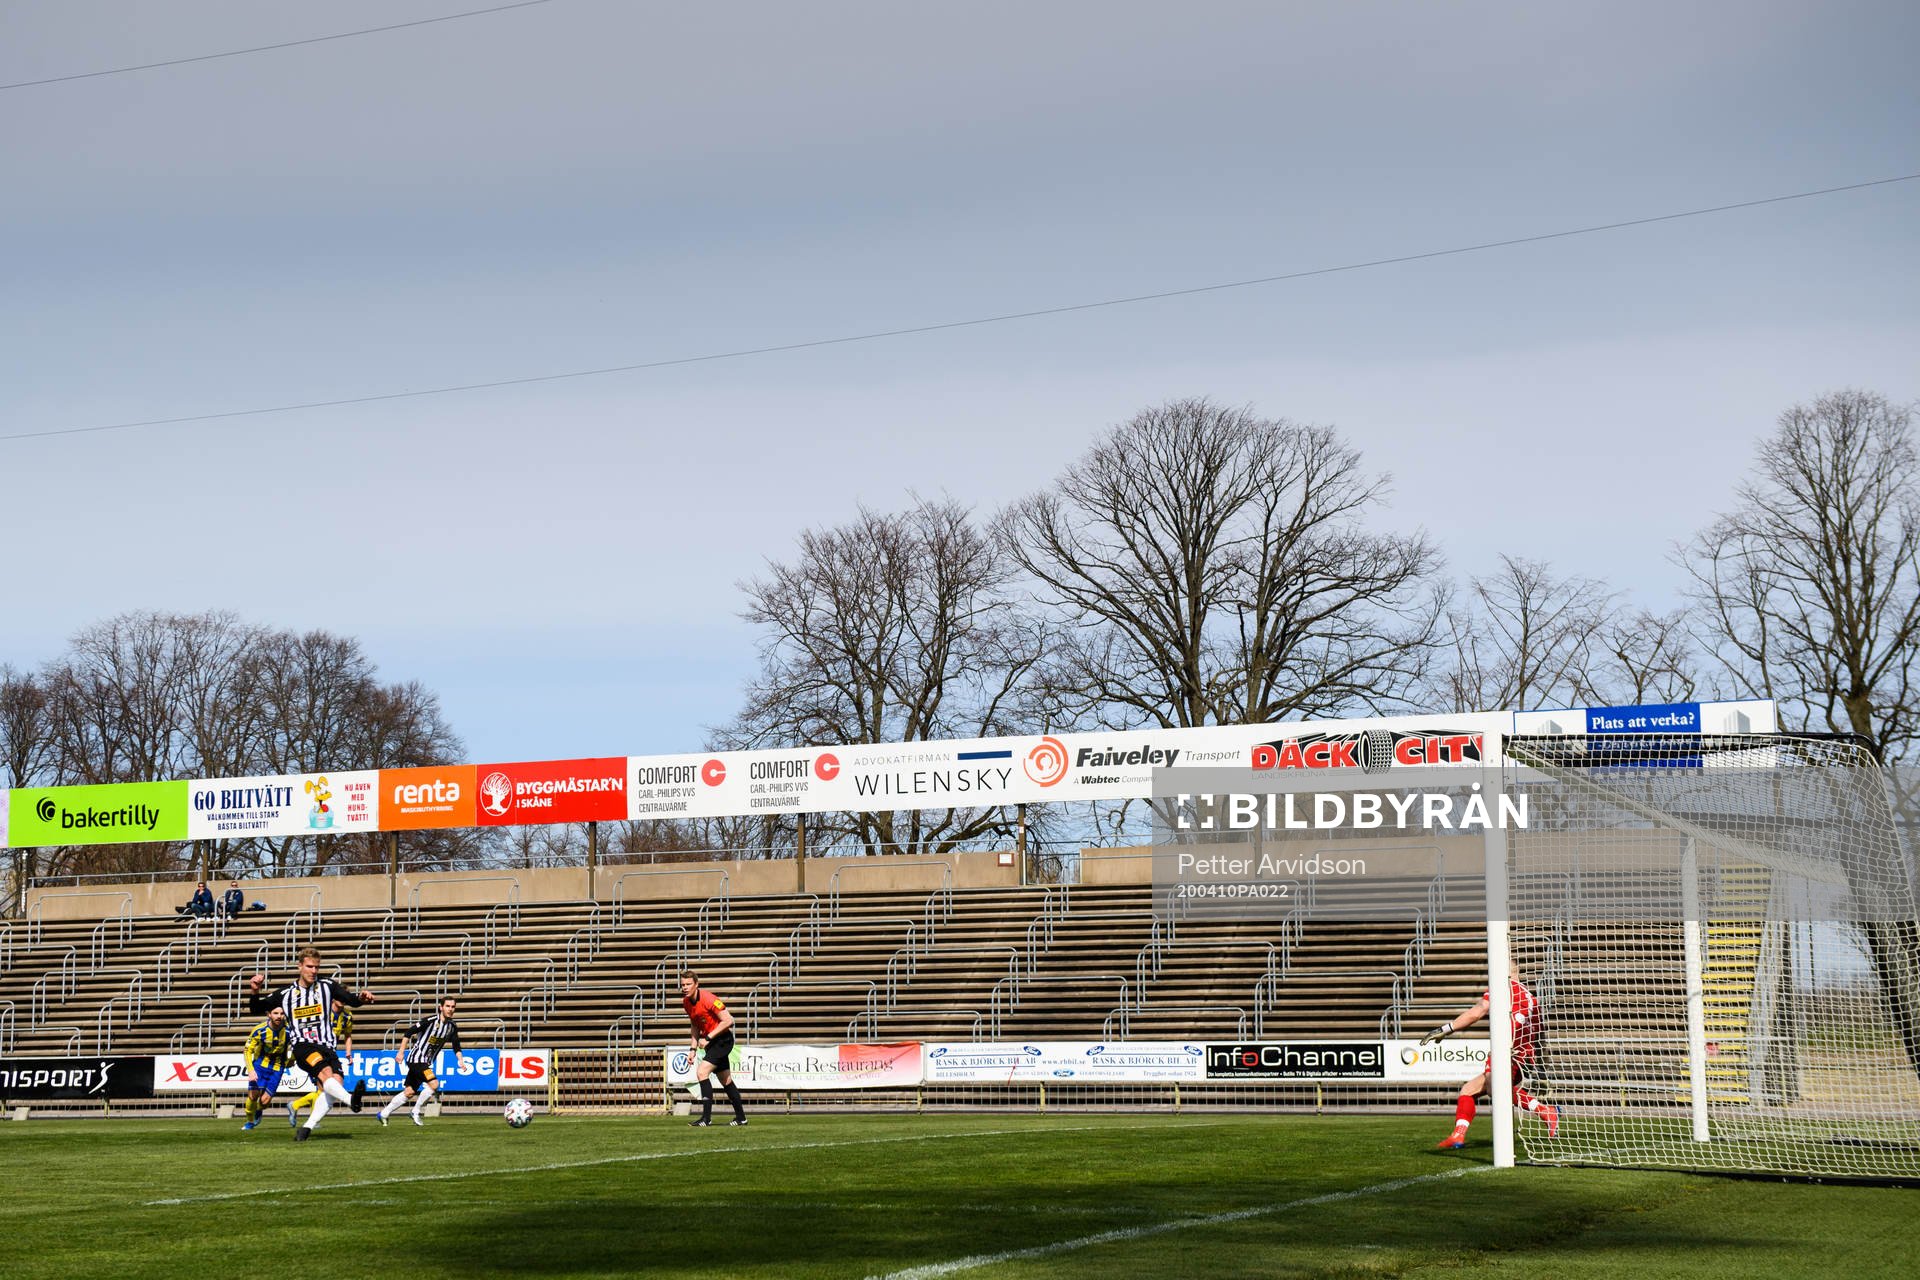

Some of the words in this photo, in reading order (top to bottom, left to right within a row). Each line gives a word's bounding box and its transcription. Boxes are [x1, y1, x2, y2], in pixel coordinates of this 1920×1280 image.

[1592, 716, 1624, 730] Plats
[1628, 717, 1646, 728] att
[1650, 712, 1695, 727] verka?
[854, 753, 950, 766] ADVOKATFIRMAN
[1076, 745, 1180, 769] Faiveley
[1184, 749, 1241, 763] Transport
[1252, 737, 1358, 771] DÄCK
[638, 765, 697, 785] COMFORT
[750, 759, 811, 780] COMFORT
[344, 783, 354, 792] NU
[750, 782, 794, 794] CARL-PHILIPS
[794, 781, 809, 792] VVS
[854, 767, 1012, 796] WILENSKY
[1073, 776, 1080, 785] A
[1081, 775, 1120, 785] Wabtec
[1121, 774, 1158, 785] Company
[194, 790, 216, 811] GO
[220, 784, 293, 809] BILTVÄTT
[351, 793, 365, 801] MED
[394, 779, 460, 804] renta
[638, 787, 681, 799] CARL-PHILIPS
[682, 786, 696, 797] VVS
[516, 799, 520, 809] I
[521, 796, 553, 808] SKÅNE
[61, 804, 161, 831] bakertilly
[246, 811, 258, 820] TILL
[260, 810, 280, 819] STANS
[936, 1058, 958, 1066] RASK
[1025, 1057, 1036, 1065] AB
[1092, 1057, 1117, 1065] RASK
[1119, 1057, 1125, 1065] &
[1128, 1055, 1165, 1065] BJÖRCK
[1186, 1057, 1197, 1065] AB
[1207, 1045, 1382, 1067] InfoChannel
[1422, 1045, 1486, 1062] nilesko
[806, 1057, 893, 1073] Restaurang
